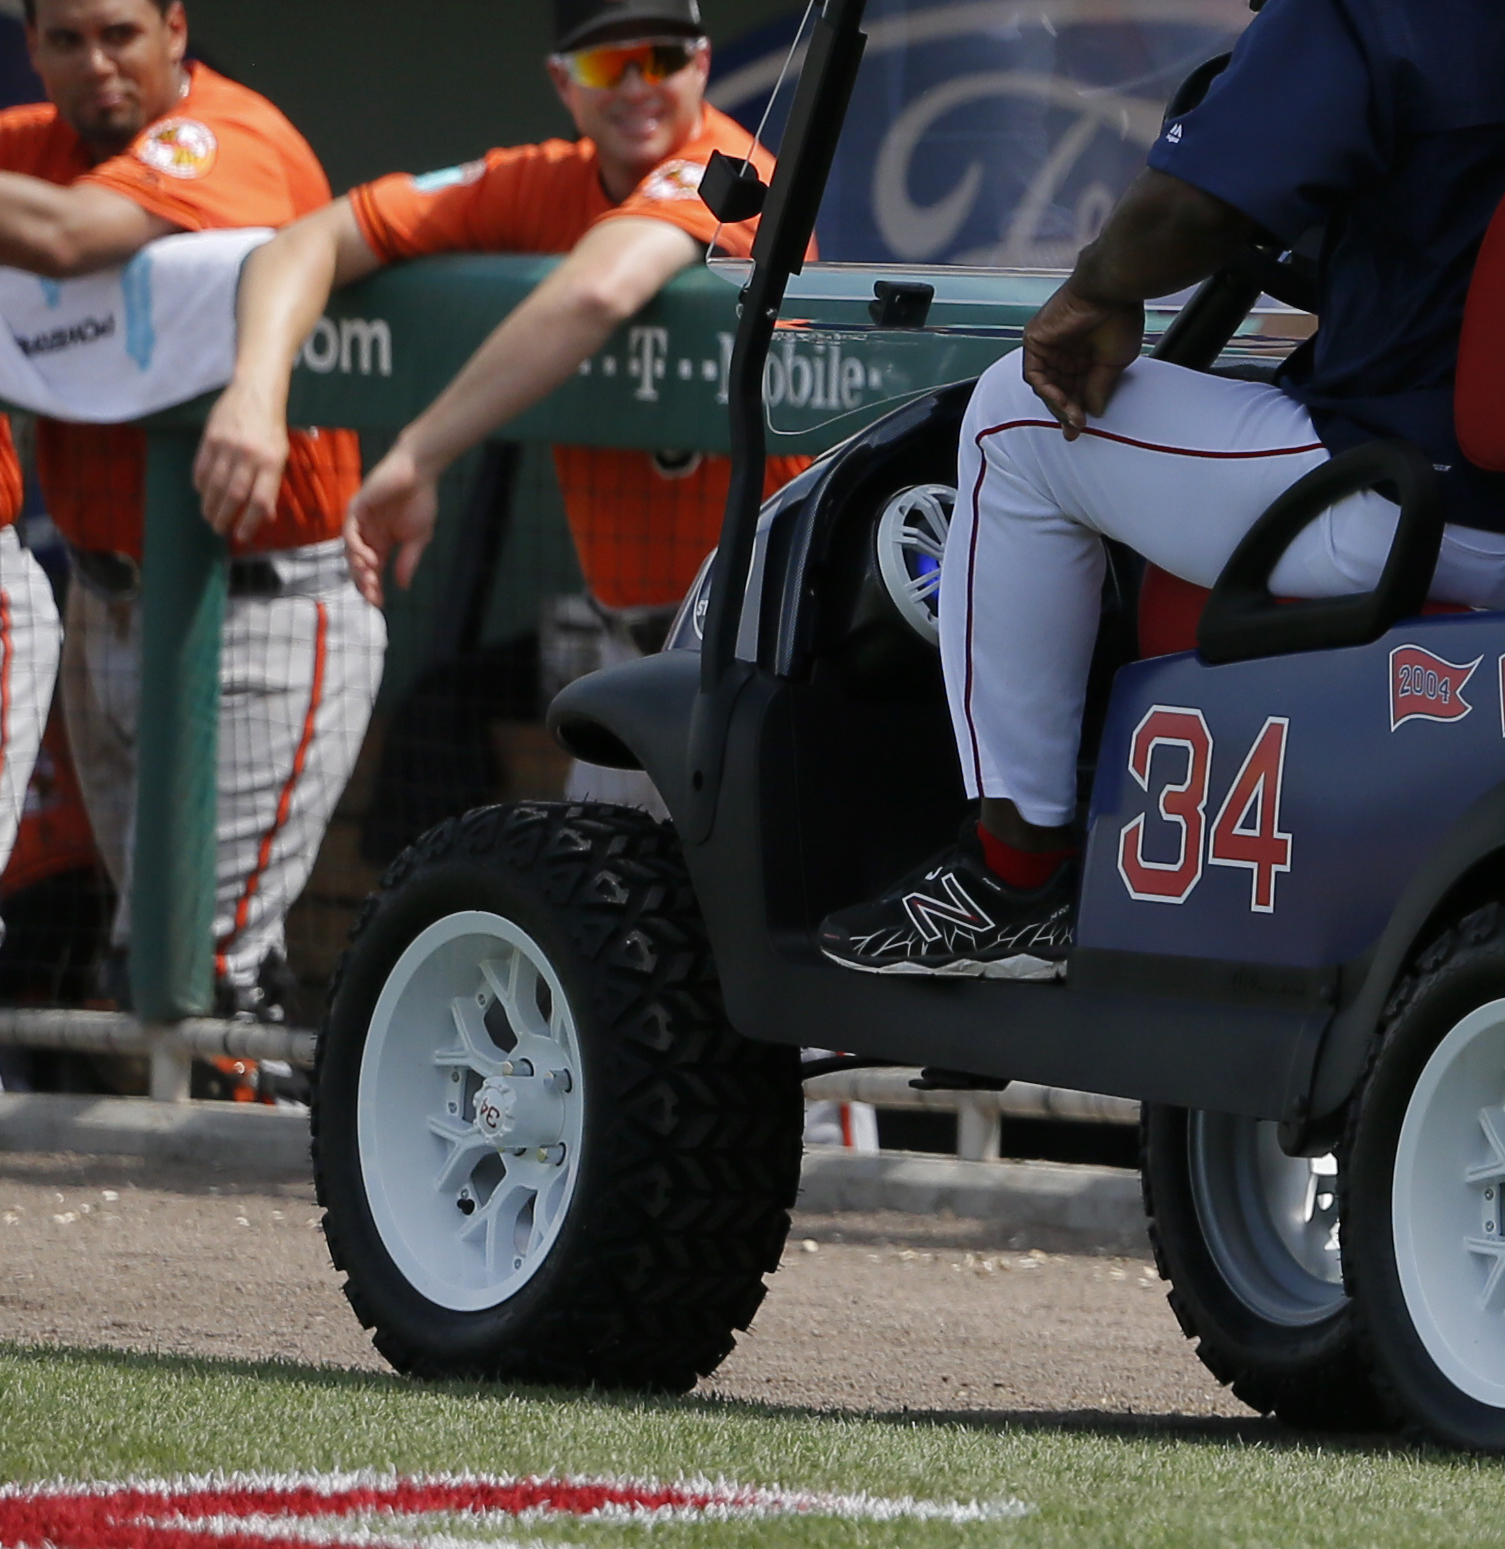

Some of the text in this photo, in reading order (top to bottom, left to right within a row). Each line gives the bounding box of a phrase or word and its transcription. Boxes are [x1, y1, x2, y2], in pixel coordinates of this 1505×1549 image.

[1398, 664, 1451, 704] 2004
[1117, 704, 1293, 914] 34
[480, 1096, 501, 1128] 34
